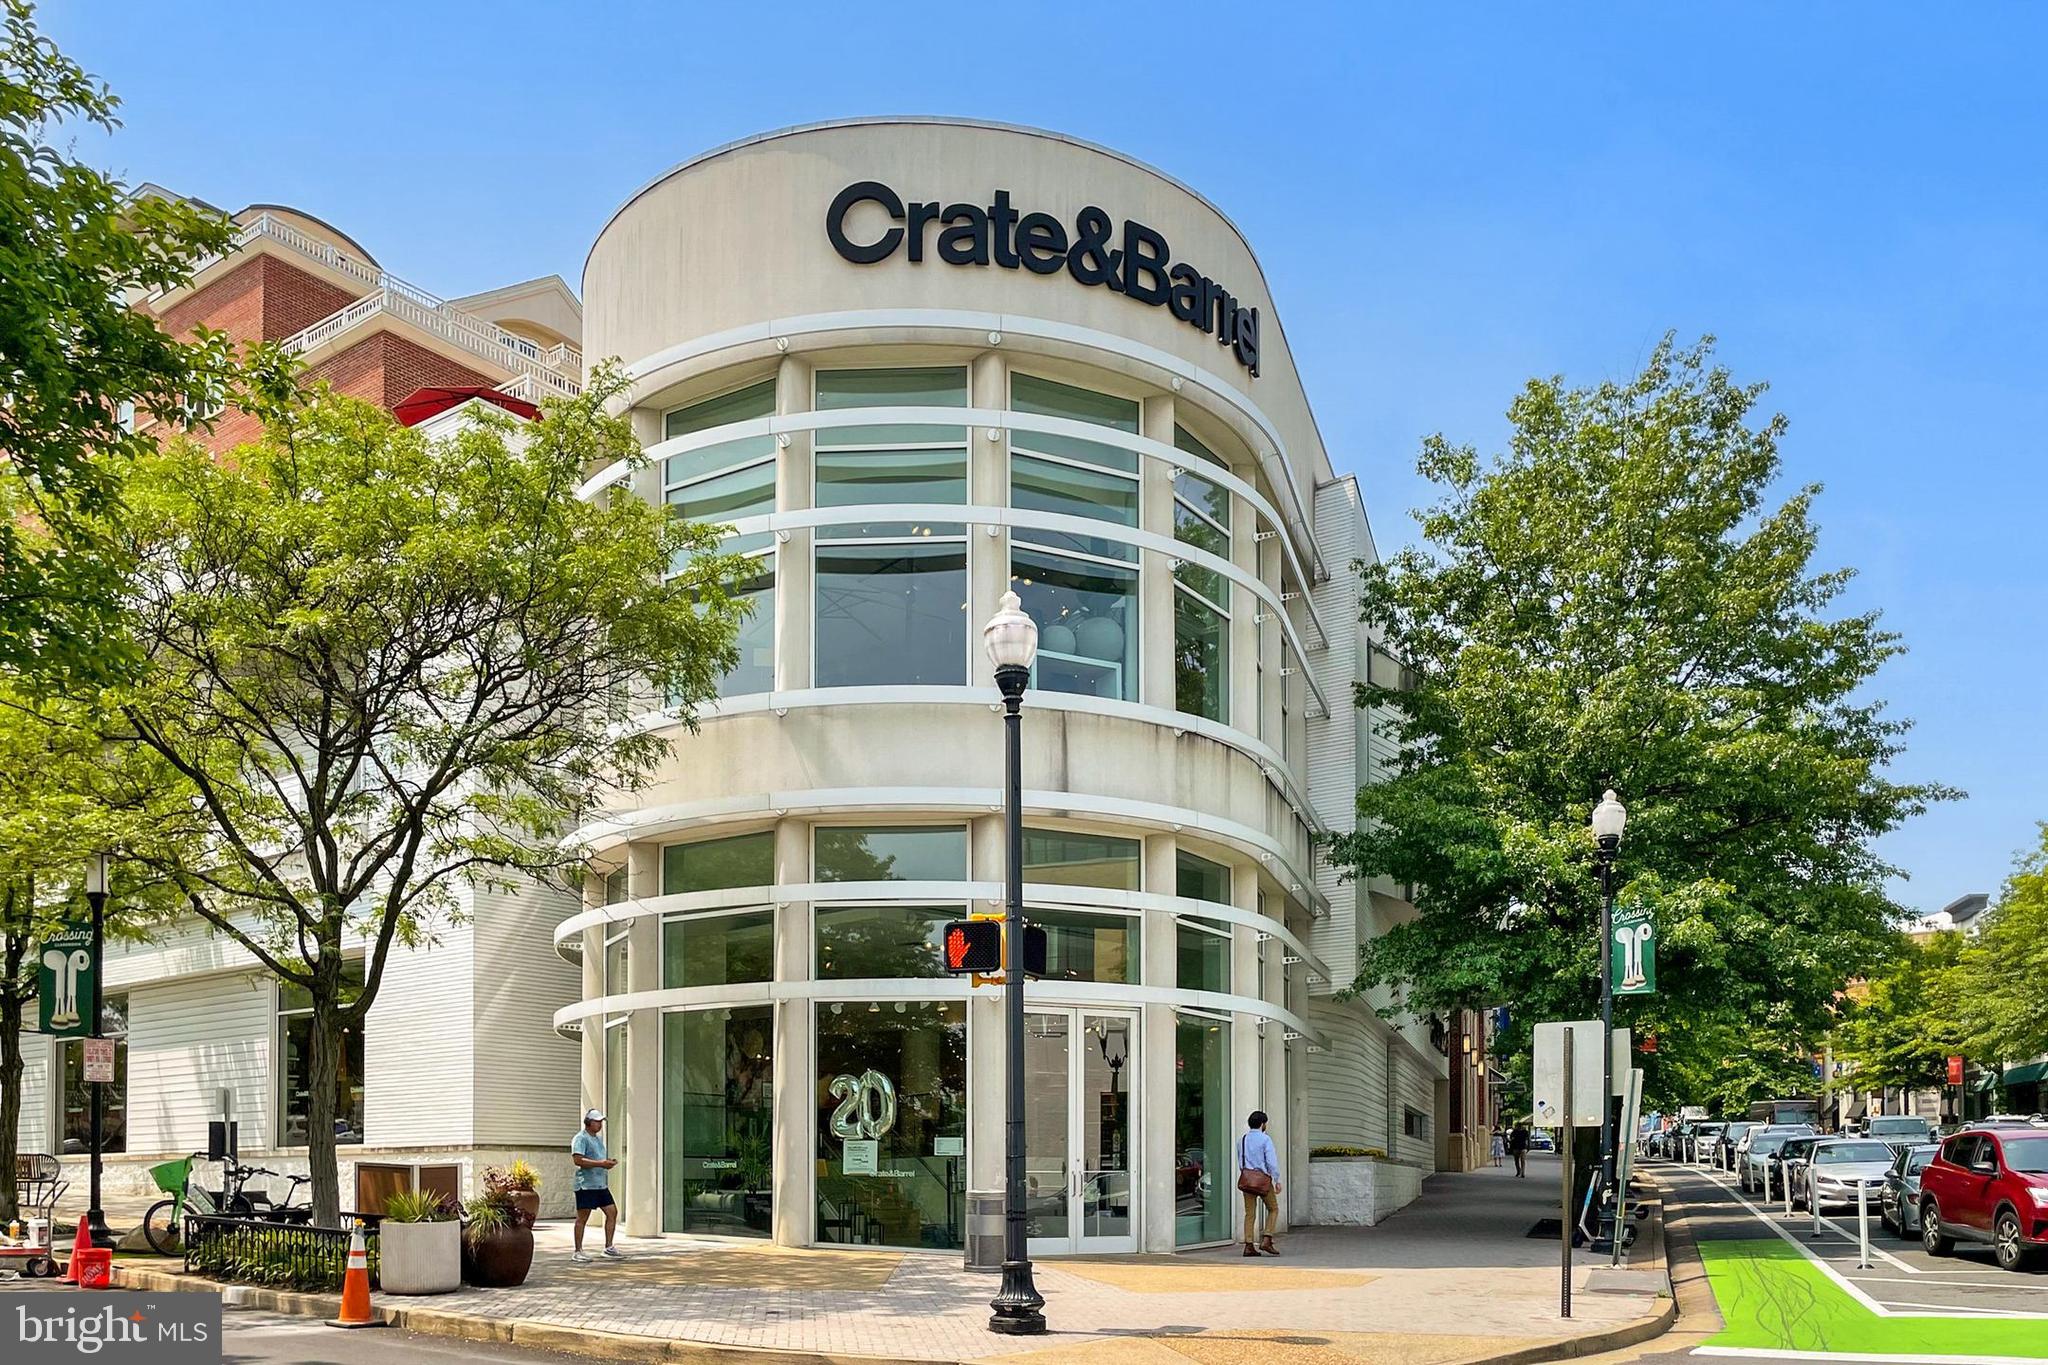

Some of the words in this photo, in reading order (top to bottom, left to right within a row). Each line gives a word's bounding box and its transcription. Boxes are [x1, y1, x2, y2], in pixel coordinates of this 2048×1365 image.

[826, 181, 1260, 379] Crate&Barrel
[41, 924, 95, 946] Crossing
[829, 1069, 897, 1139] 20
